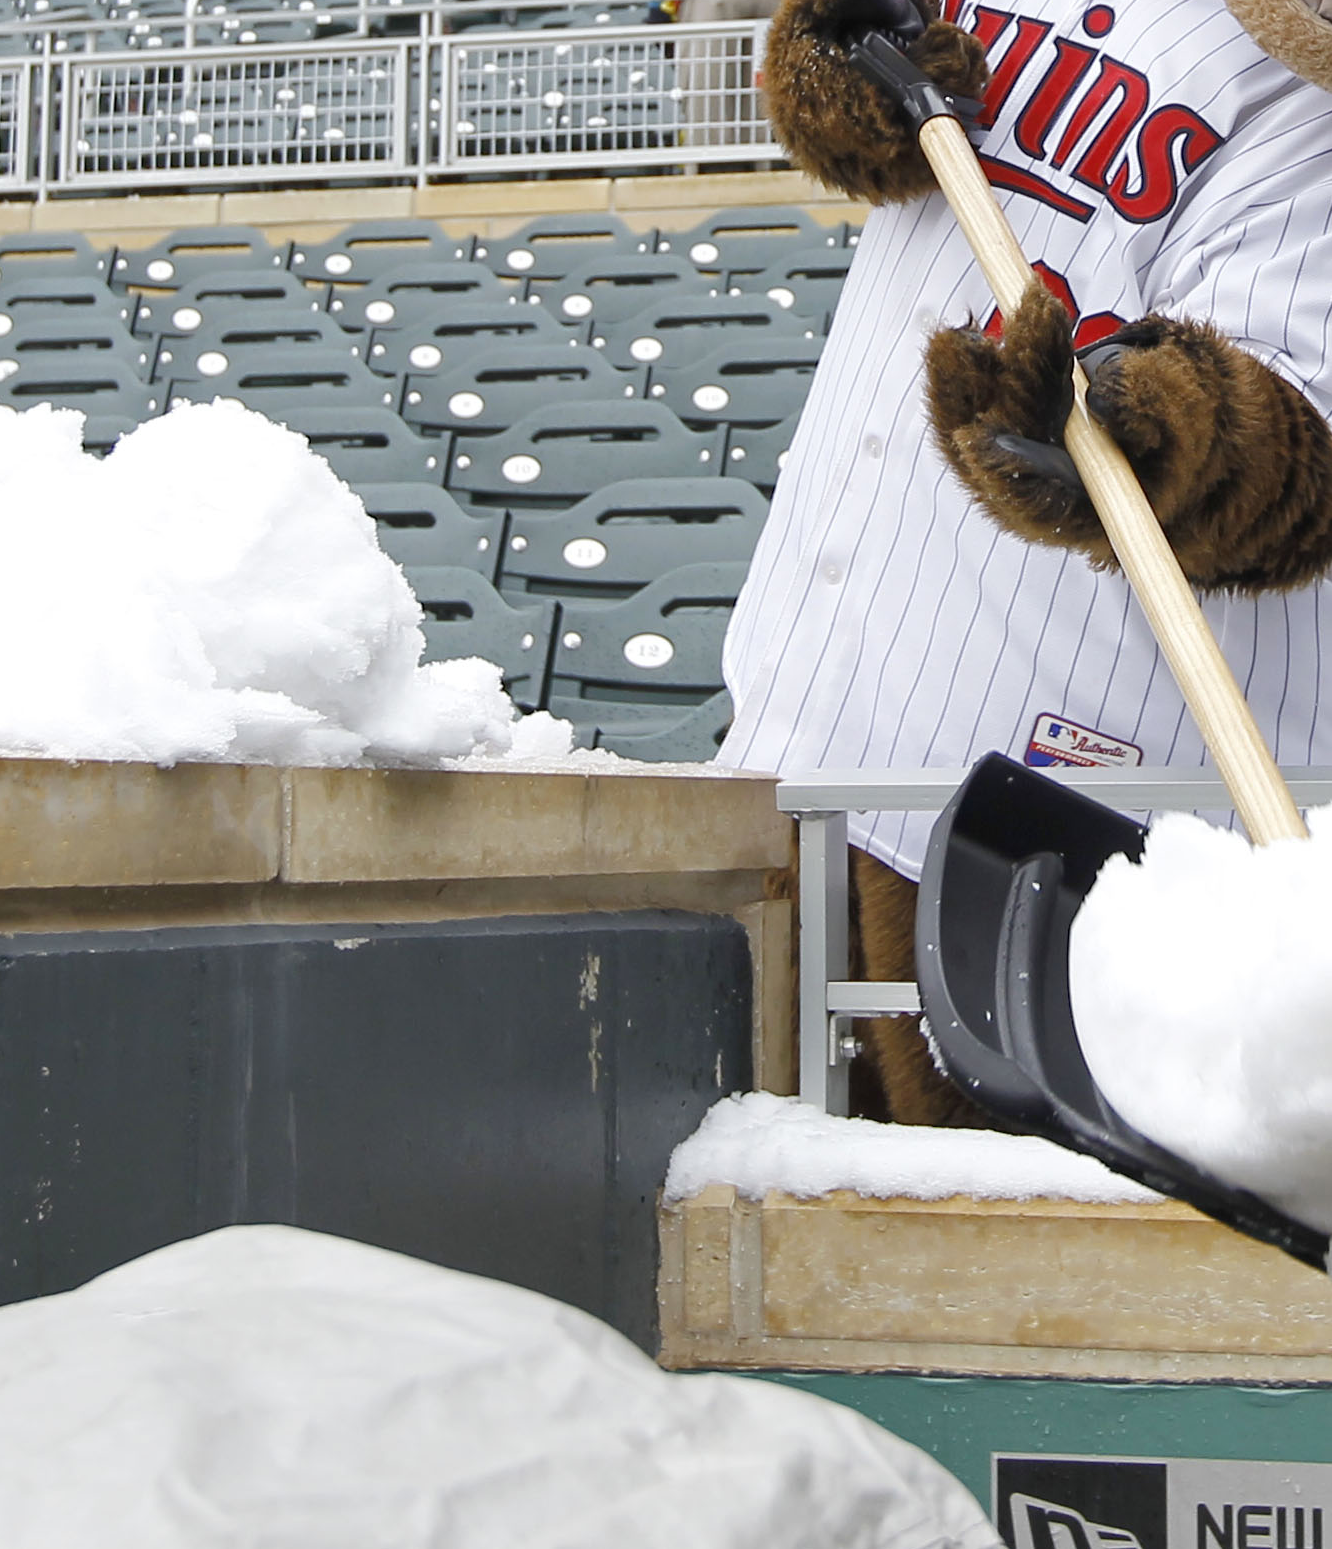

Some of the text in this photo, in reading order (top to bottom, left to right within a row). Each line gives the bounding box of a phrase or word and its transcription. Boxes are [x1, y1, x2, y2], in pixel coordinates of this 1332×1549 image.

[639, 644, 660, 658] 12
[1070, 736, 1127, 758] Authentic
[1197, 1503, 1323, 1549] NEW
